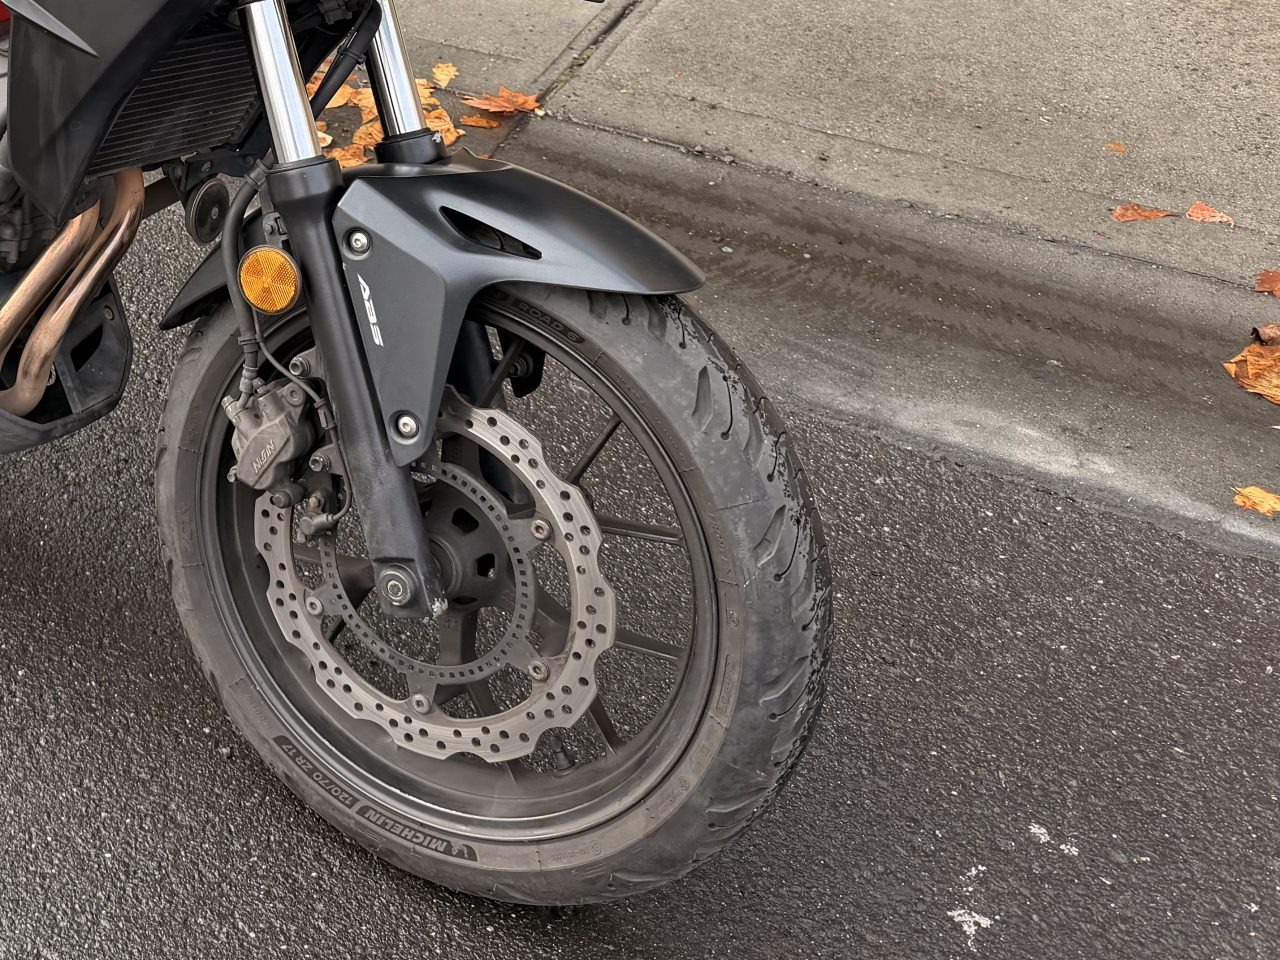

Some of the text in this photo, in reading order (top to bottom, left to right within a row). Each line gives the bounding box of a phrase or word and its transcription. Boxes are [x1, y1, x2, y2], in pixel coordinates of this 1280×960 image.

[357, 273, 384, 347] ABS
[520, 302, 563, 331] ROAD
[281, 743, 354, 805] 120/70 ZR 17
[364, 809, 447, 852] MICHELIN
